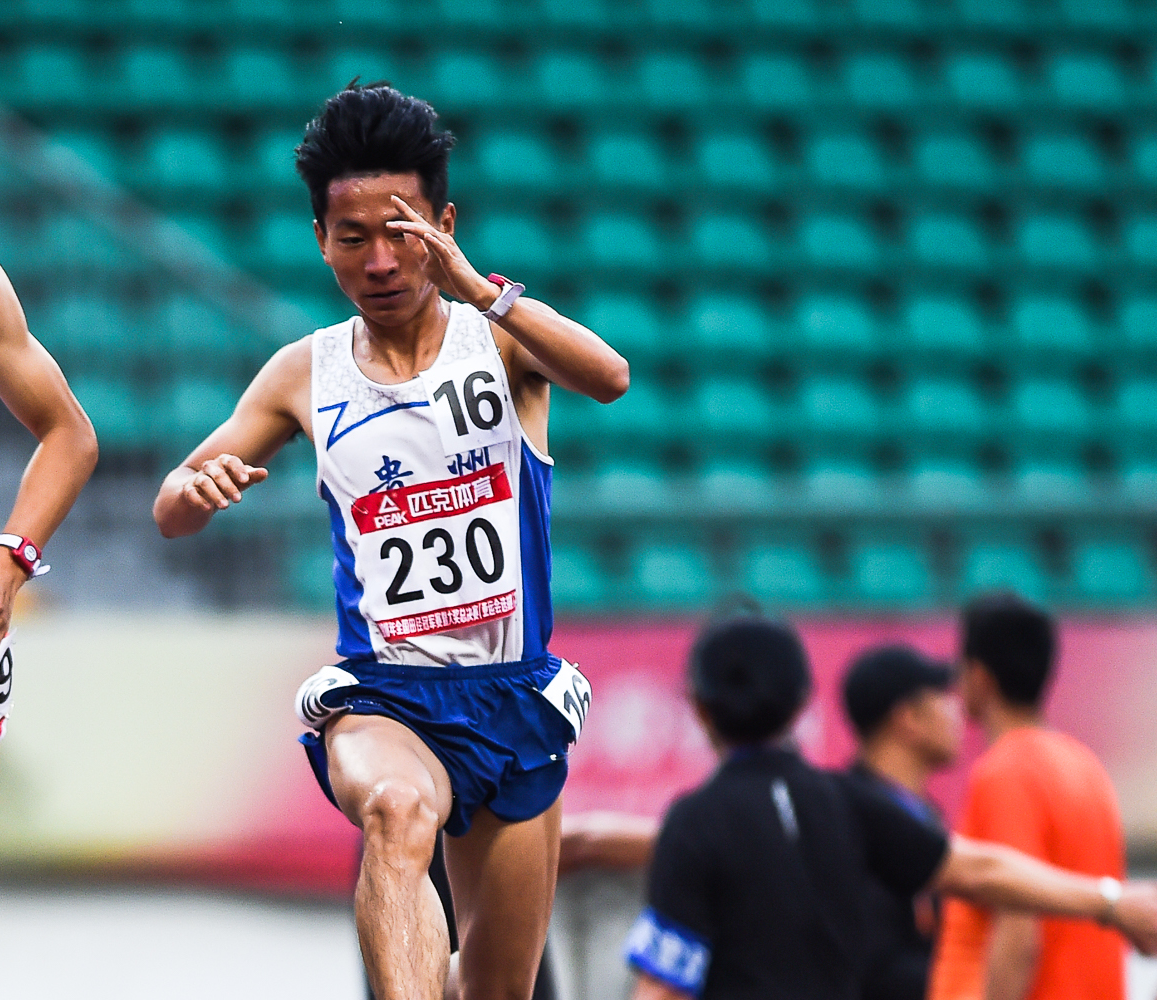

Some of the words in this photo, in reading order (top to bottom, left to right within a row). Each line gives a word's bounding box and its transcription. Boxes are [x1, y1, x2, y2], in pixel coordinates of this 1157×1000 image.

[432, 370, 504, 437] 16
[373, 511, 409, 529] PEAK
[407, 476, 494, 519] 匹克体育
[380, 517, 505, 606] 230
